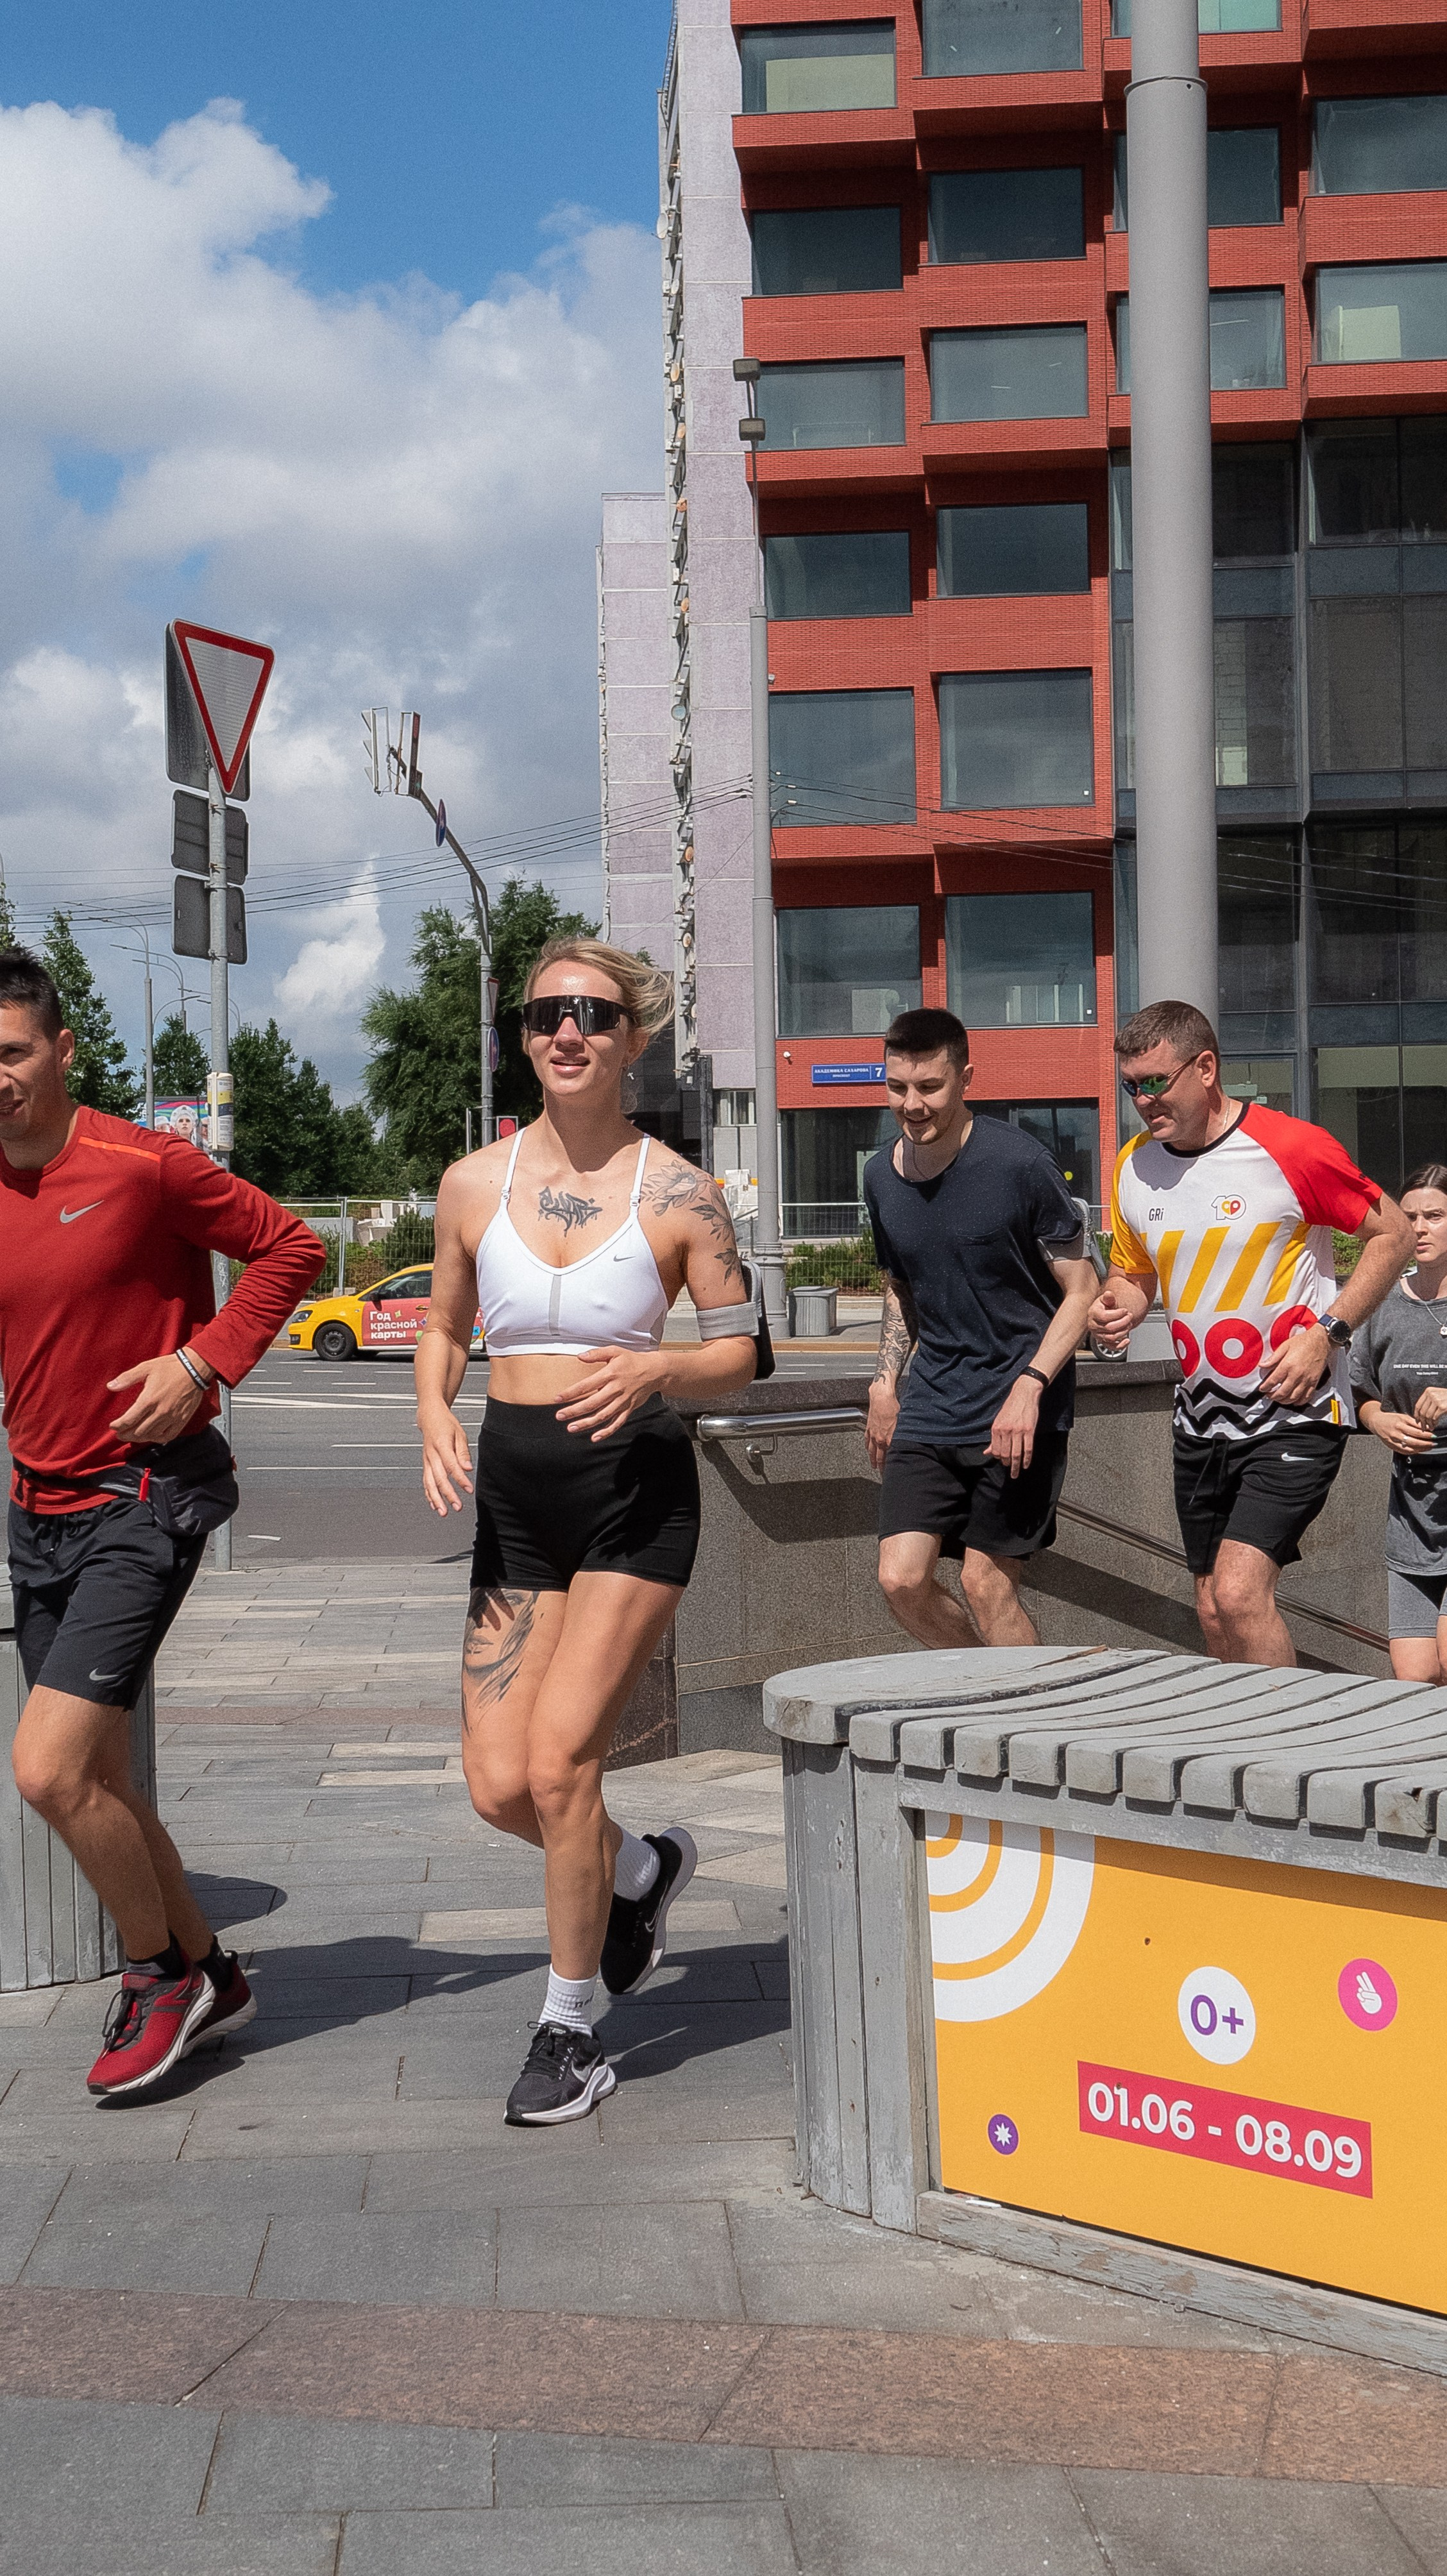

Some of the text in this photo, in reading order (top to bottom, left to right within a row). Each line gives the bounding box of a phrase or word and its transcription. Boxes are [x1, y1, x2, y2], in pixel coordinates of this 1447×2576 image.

[875, 1067, 883, 1078] 7
[369, 1311, 391, 1321] Год
[370, 1319, 418, 1332] красной
[371, 1330, 406, 1341] карты
[1190, 1994, 1244, 2037] 0+
[1088, 2082, 1195, 2141] 01.06
[1235, 2114, 1362, 2178] 08.09
